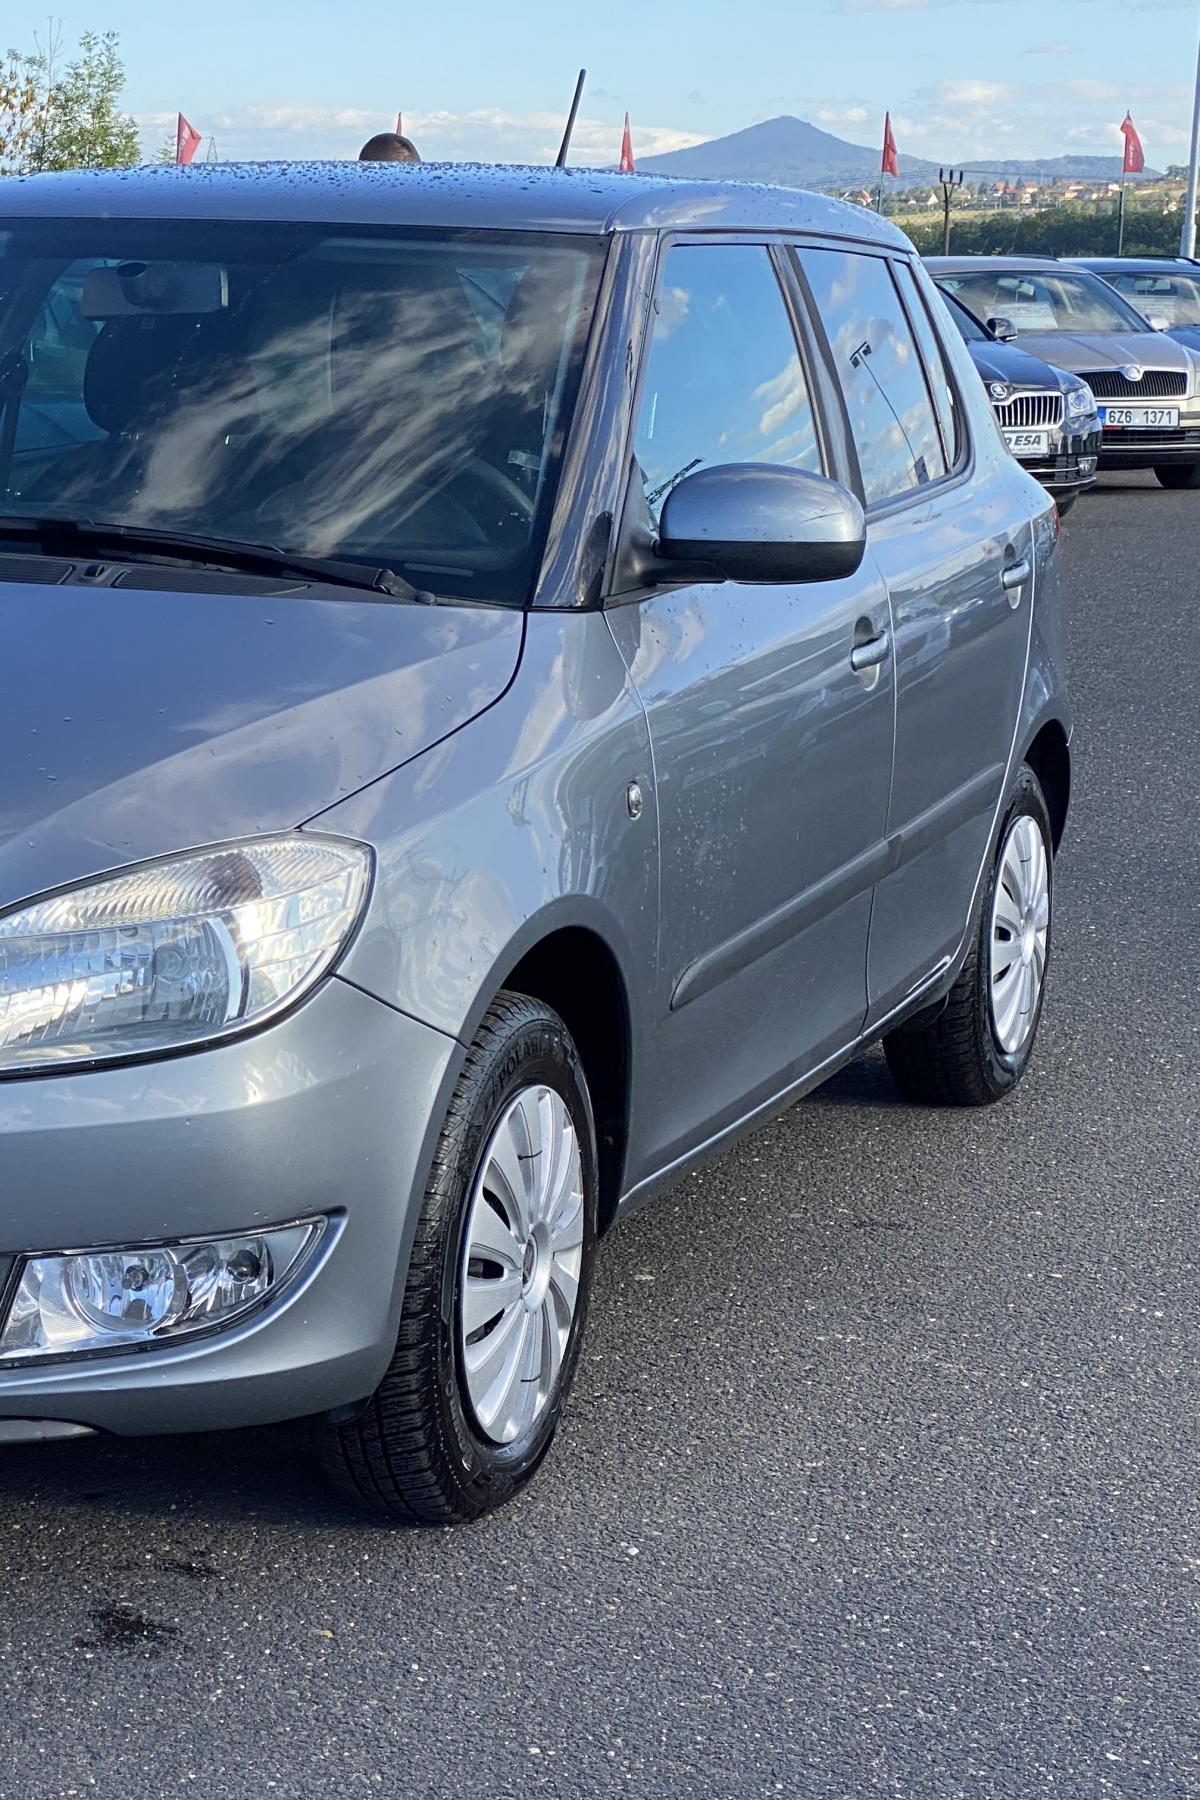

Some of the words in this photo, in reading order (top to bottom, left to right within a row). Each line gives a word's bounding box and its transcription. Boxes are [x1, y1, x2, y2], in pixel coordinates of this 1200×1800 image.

[1108, 410, 1132, 424] 6Z6
[1143, 410, 1172, 424] 1371
[1014, 434, 1042, 446] ESA
